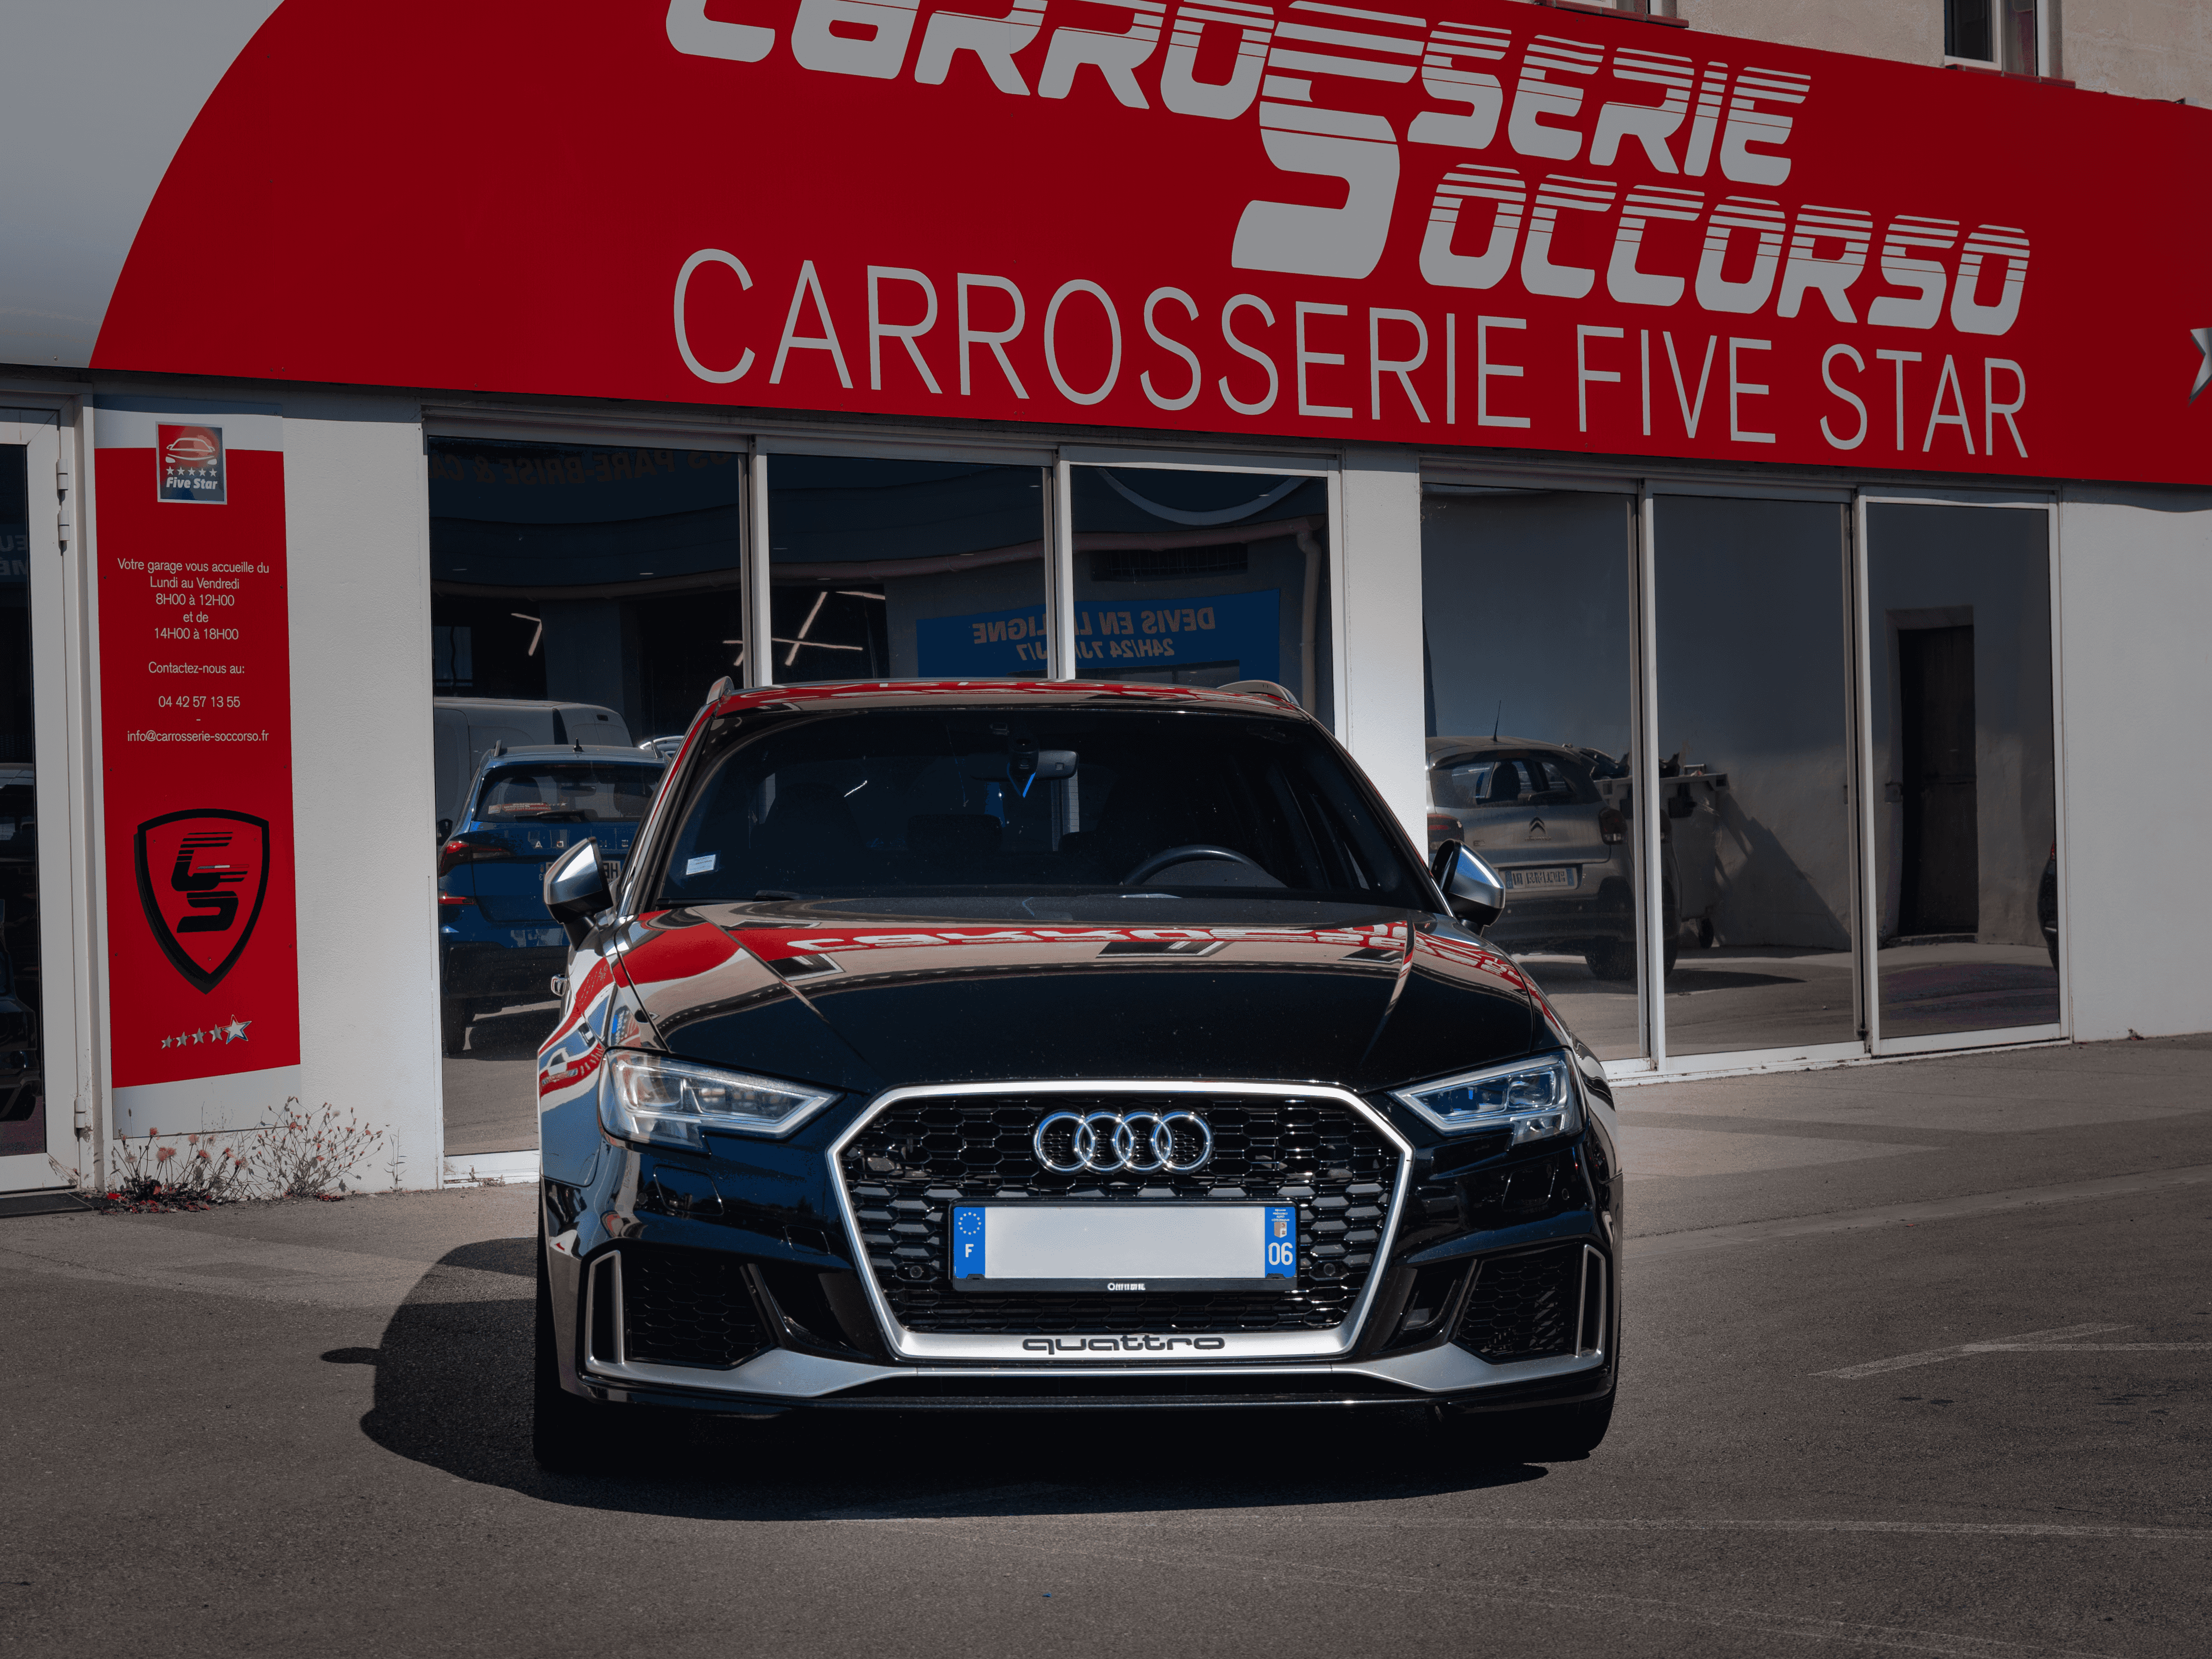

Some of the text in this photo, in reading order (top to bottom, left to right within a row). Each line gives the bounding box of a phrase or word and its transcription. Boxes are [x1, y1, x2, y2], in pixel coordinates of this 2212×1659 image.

[674, 248, 2028, 458] CARROSSERIE FIVE STAR
[166, 477, 218, 490] Five Star
[117, 558, 269, 574] Votre garage vous accueille du
[150, 576, 239, 589] Lundi au Vendredi
[156, 593, 235, 606] 8H00 à 12H00
[183, 611, 209, 623] et de
[155, 627, 239, 640] 14H00 à 18H00
[148, 661, 245, 674] Contactez-nous au:
[158, 696, 240, 708] 04 42 57 13 55
[127, 729, 269, 742] info@carrosserie-soccorso.fr
[965, 1242, 1293, 1266] F 06
[1023, 1334, 1225, 1355] quattro
